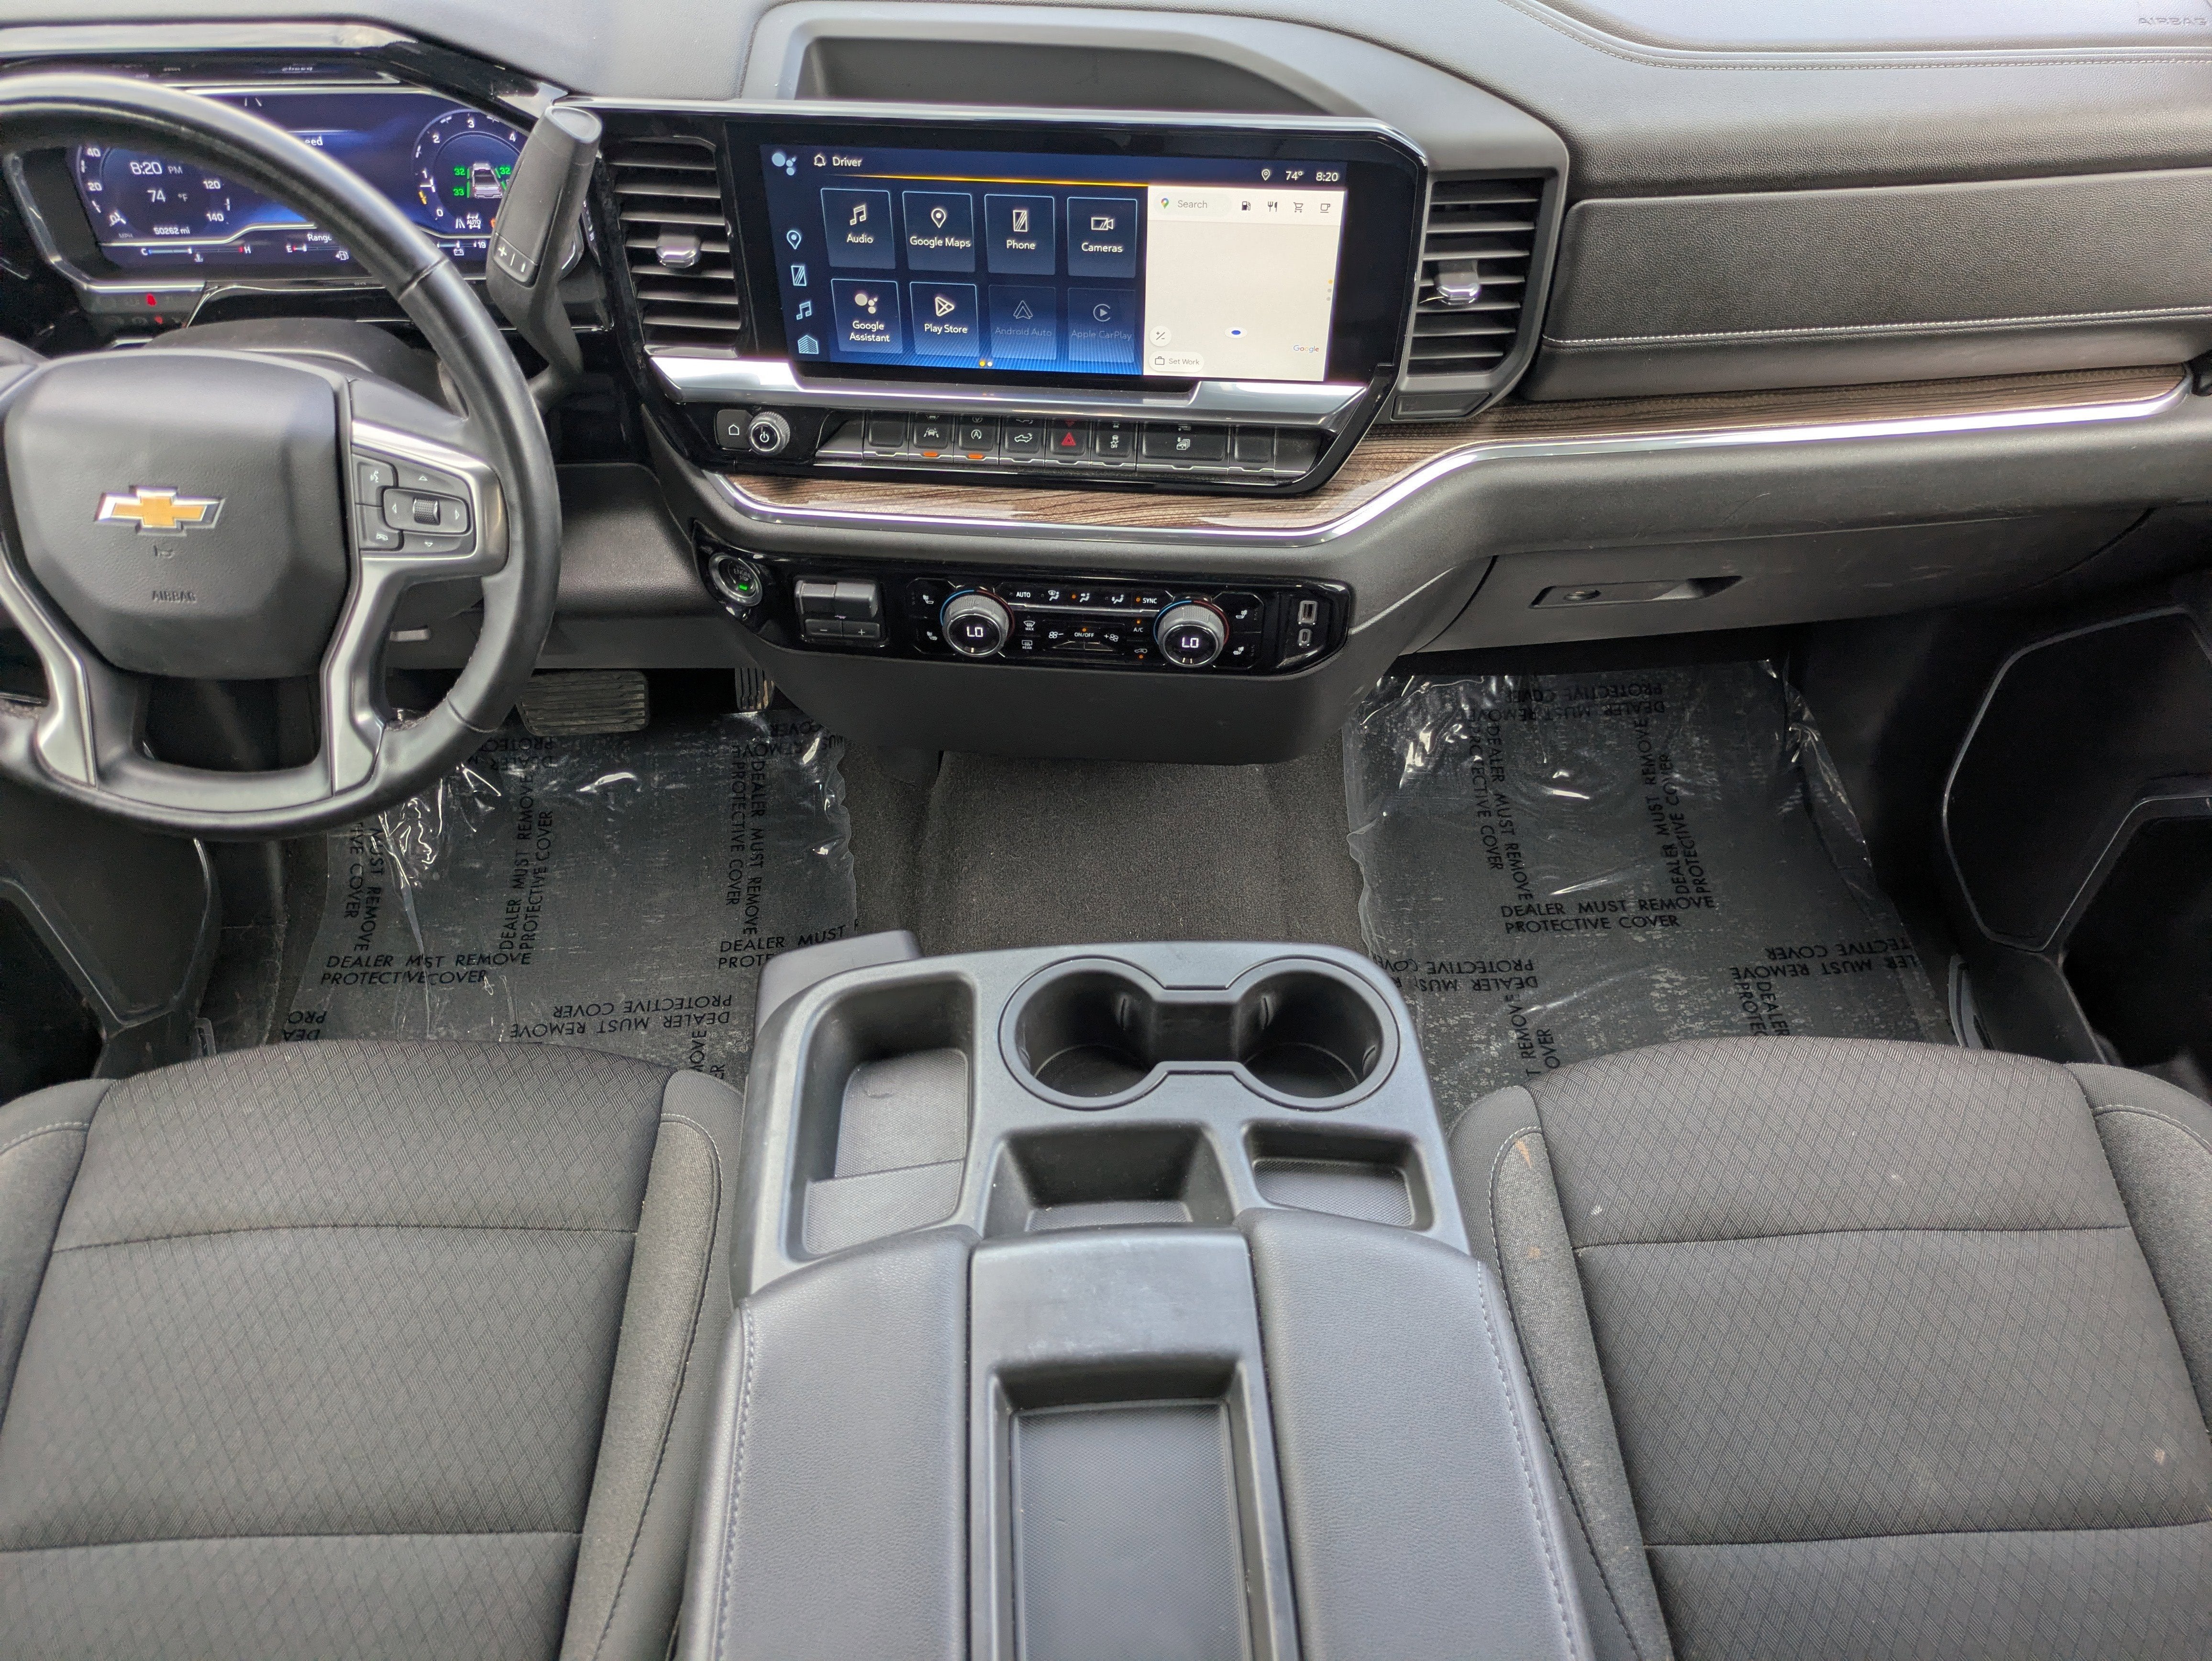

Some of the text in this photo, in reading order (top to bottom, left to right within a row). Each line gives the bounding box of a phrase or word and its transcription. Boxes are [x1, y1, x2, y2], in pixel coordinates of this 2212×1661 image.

[467, 119, 475, 128] 3
[432, 134, 440, 144] 2
[509, 133, 516, 142] 4
[86, 147, 101, 157] 40
[130, 161, 183, 175] 8:20 PM
[832, 156, 863, 167] Driver
[454, 167, 466, 176] 32
[499, 166, 511, 175] 32
[1285, 170, 1304, 181] 74°
[1316, 171, 1339, 182] 8:20
[88, 182, 103, 191] 20
[202, 180, 221, 190] 120
[147, 189, 166, 203] 74
[453, 188, 465, 196] 33
[1177, 199, 1208, 209] Search
[206, 212, 225, 223] 140
[180, 226, 191, 234] mi
[847, 233, 874, 244] Audio
[910, 236, 971, 249] Google Maps
[1006, 240, 1036, 250] Phone
[1081, 242, 1123, 253] Cameras
[852, 321, 885, 331] Google
[924, 323, 968, 335] Play Store
[995, 327, 1052, 337] Android Auto
[849, 332, 890, 343] Assistant
[1071, 329, 1132, 342] Apple CarPlay
[1293, 344, 1319, 354] Google
[152, 590, 196, 601] AIRBAG
[966, 626, 984, 638] LO
[1181, 636, 1199, 649] LO
[1604, 700, 1665, 716] DEALER
[1634, 718, 1691, 895] DEALER MUST REMOVE
[1486, 726, 1535, 902] DEALER MUST REMOVE
[725, 761, 746, 906] PROTECTIVE COVER
[742, 761, 765, 935] DEALER MUST REMOVE
[1480, 824, 1504, 871] COVER
[1669, 812, 1711, 895] PROTECTIVE
[498, 775, 534, 951] DEALER MUST REMOVE
[519, 810, 553, 951] PROTECTIVE COVER
[343, 863, 364, 919] COVER
[1500, 896, 1716, 918] DEALER MUST REMOVE
[354, 886, 382, 952] REMOVE
[1504, 914, 1681, 934] PROTECTIVE COVER
[720, 936, 785, 952] DEALER
[797, 924, 846, 948] MUST
[1765, 944, 1828, 961] COVER
[326, 951, 533, 969] DEALER MST REMOVE
[1426, 958, 1535, 975] PROTECTIVE
[1729, 963, 1810, 980] REMOVE
[1821, 959, 1873, 975] MUST
[321, 969, 488, 986] PROTECTIVE COVER
[1470, 975, 1539, 992] DEALER
[552, 994, 733, 1019] PROTECTIVE COVER
[1756, 981, 1791, 1036] DEALER
[509, 1011, 730, 1039] DEALER MUST REMOVE
[1504, 994, 1537, 1059] REMOVE
[1535, 1028, 1561, 1070] OVER
